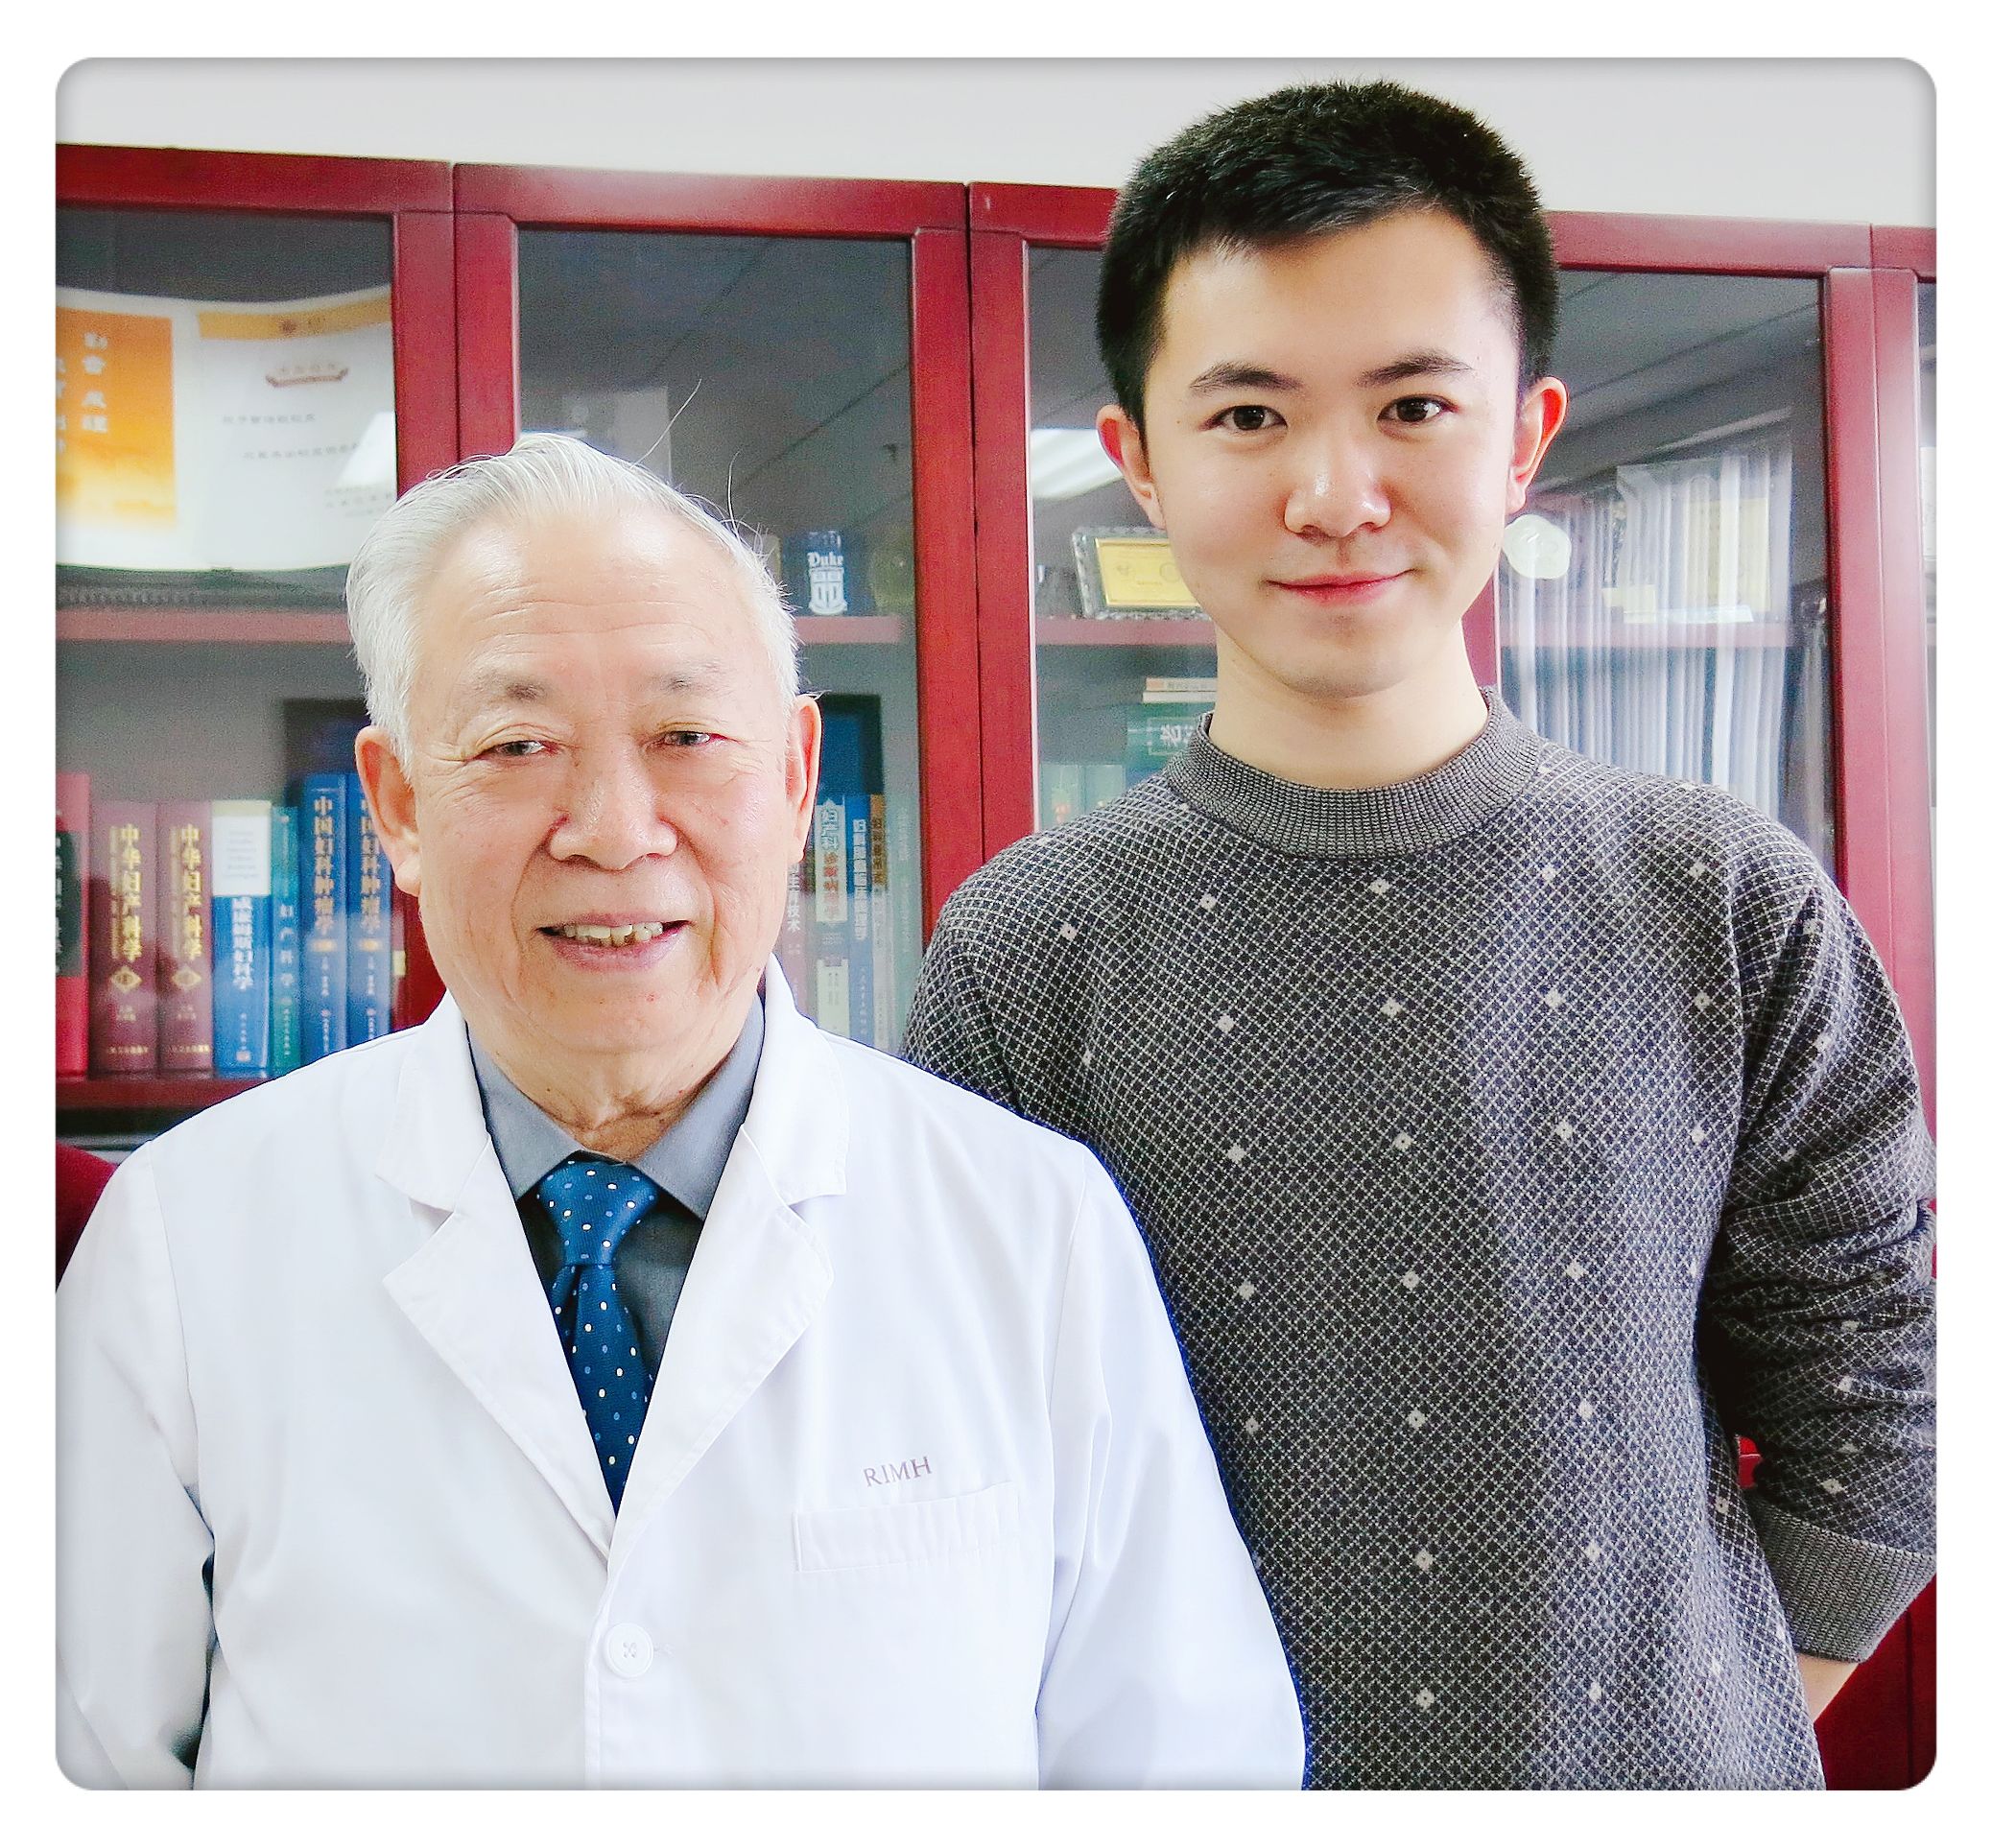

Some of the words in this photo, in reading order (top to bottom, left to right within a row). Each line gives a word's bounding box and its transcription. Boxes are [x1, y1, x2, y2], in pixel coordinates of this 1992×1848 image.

[807, 551, 844, 567] Duke
[120, 822, 142, 962] 中华妇产科学
[180, 822, 202, 961] 中华妇产科学
[314, 794, 334, 937] 中国妇科肿瘤学
[864, 1456, 933, 1487] RIMH
